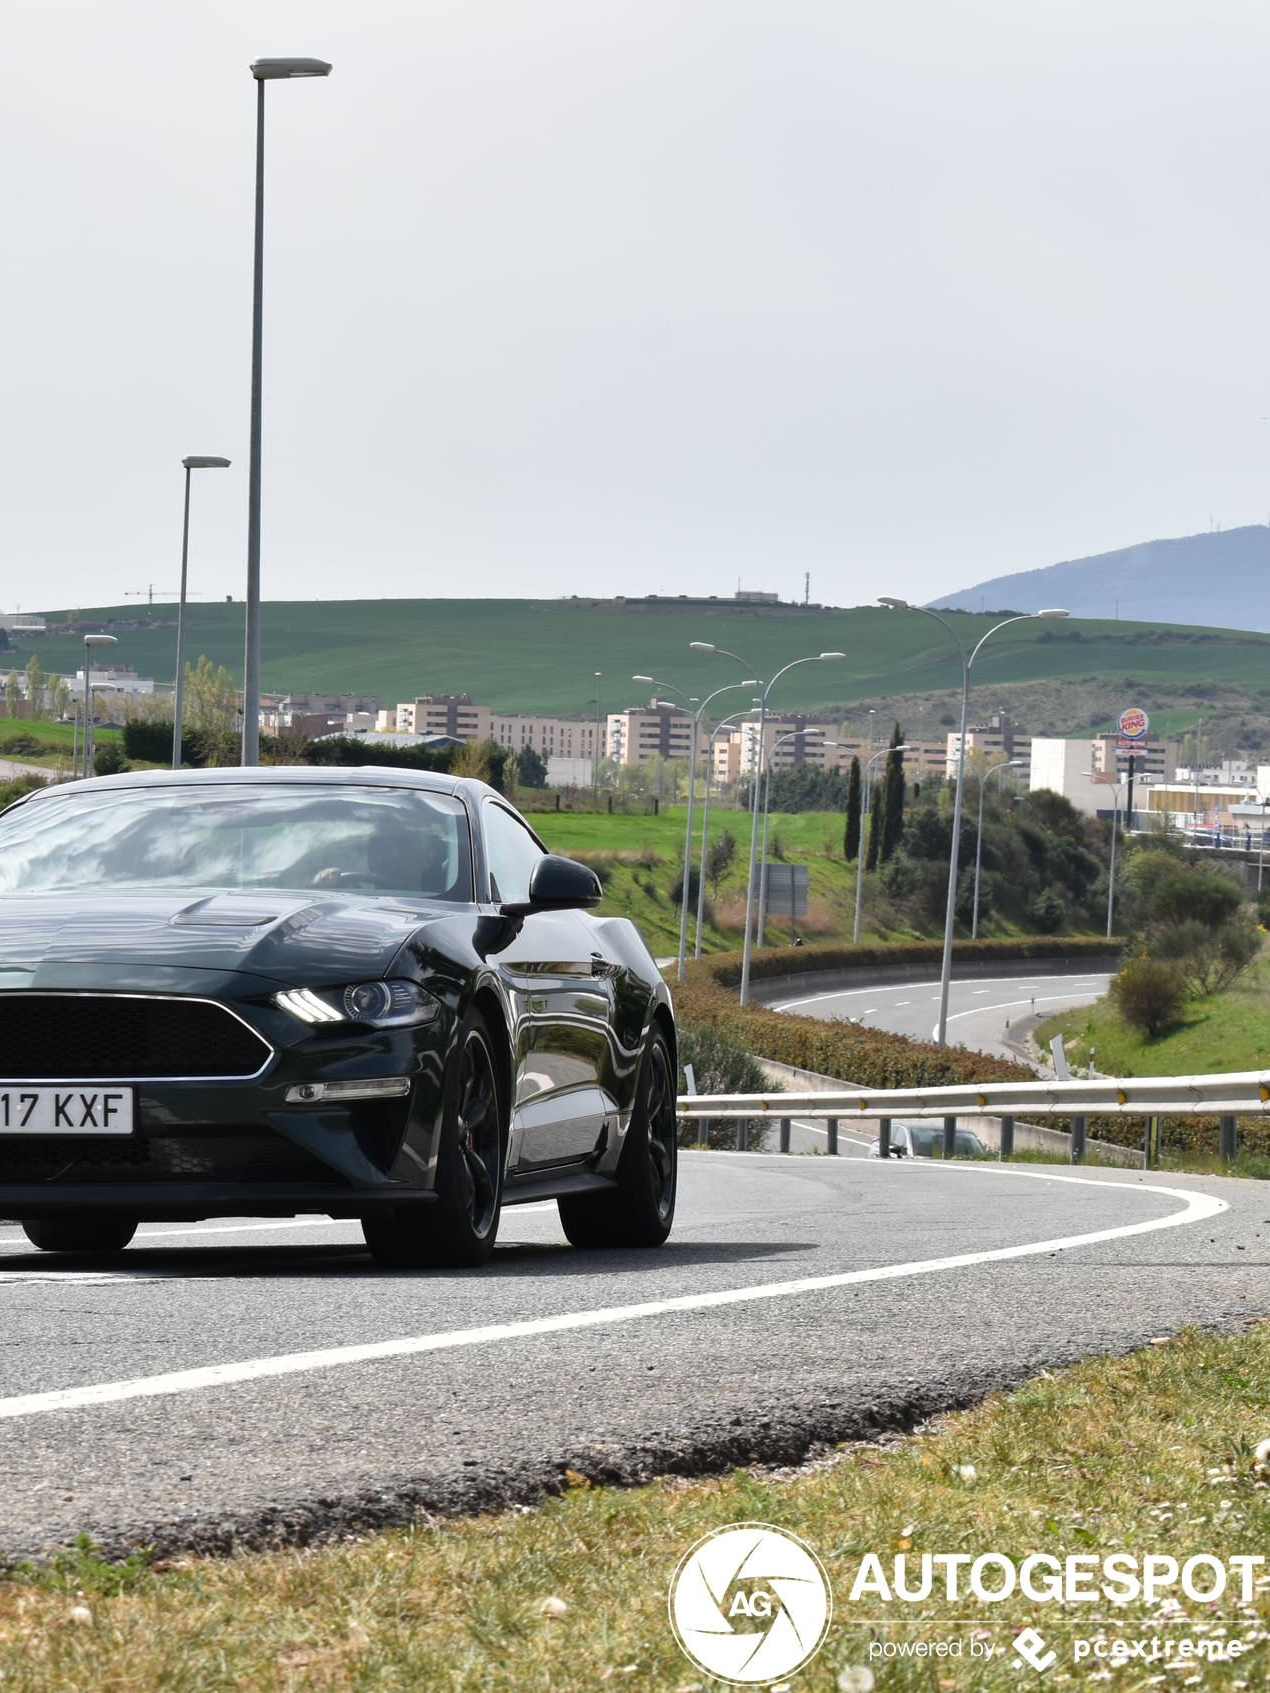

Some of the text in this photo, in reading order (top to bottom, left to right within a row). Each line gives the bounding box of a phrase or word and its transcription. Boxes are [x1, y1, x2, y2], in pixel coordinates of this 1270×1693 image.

[1121, 713, 1145, 725] BURGER
[1121, 719, 1145, 732] KING
[54, 1093, 123, 1128] KXF
